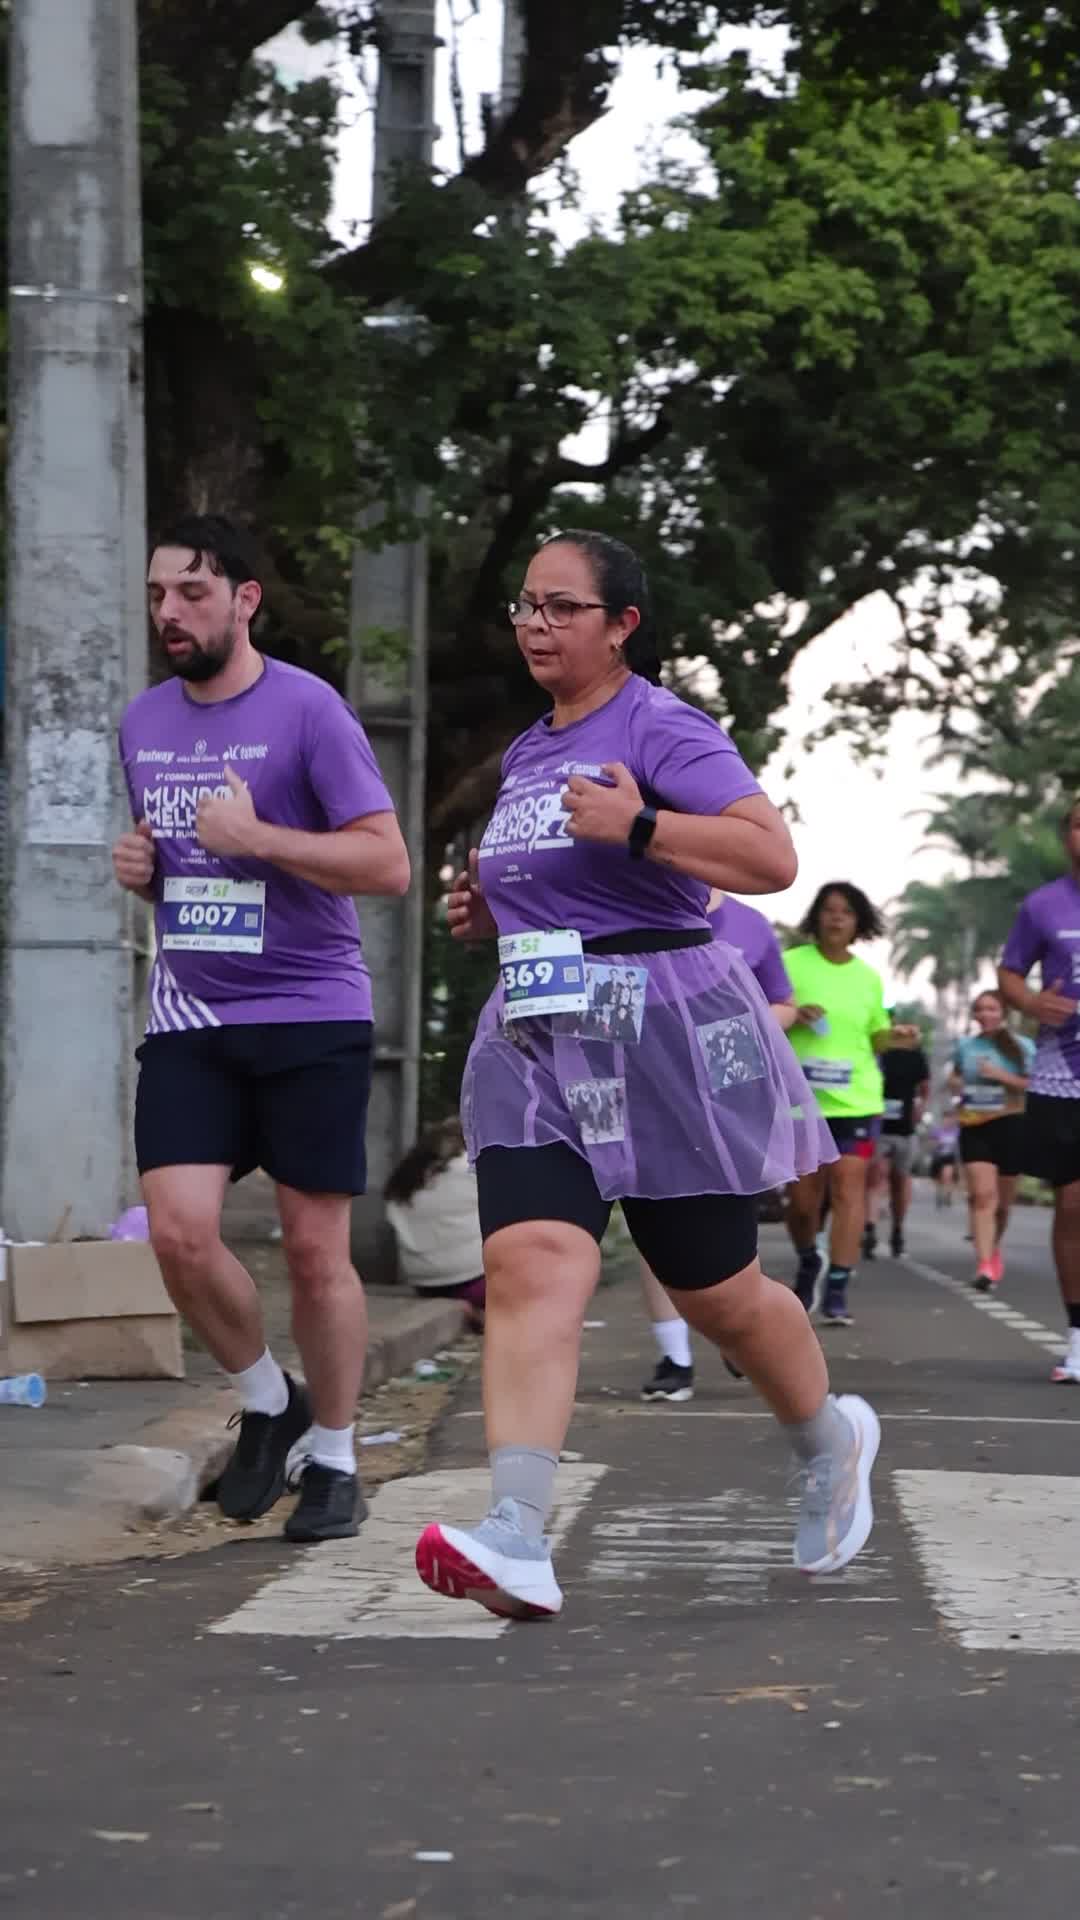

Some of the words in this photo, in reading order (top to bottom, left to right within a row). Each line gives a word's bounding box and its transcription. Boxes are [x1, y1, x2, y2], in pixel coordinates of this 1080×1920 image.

[145, 807, 197, 829] MELH
[493, 794, 553, 826] MUNDO
[480, 817, 550, 848] MELHOR
[178, 904, 237, 926] 6007
[501, 961, 554, 990] 369
